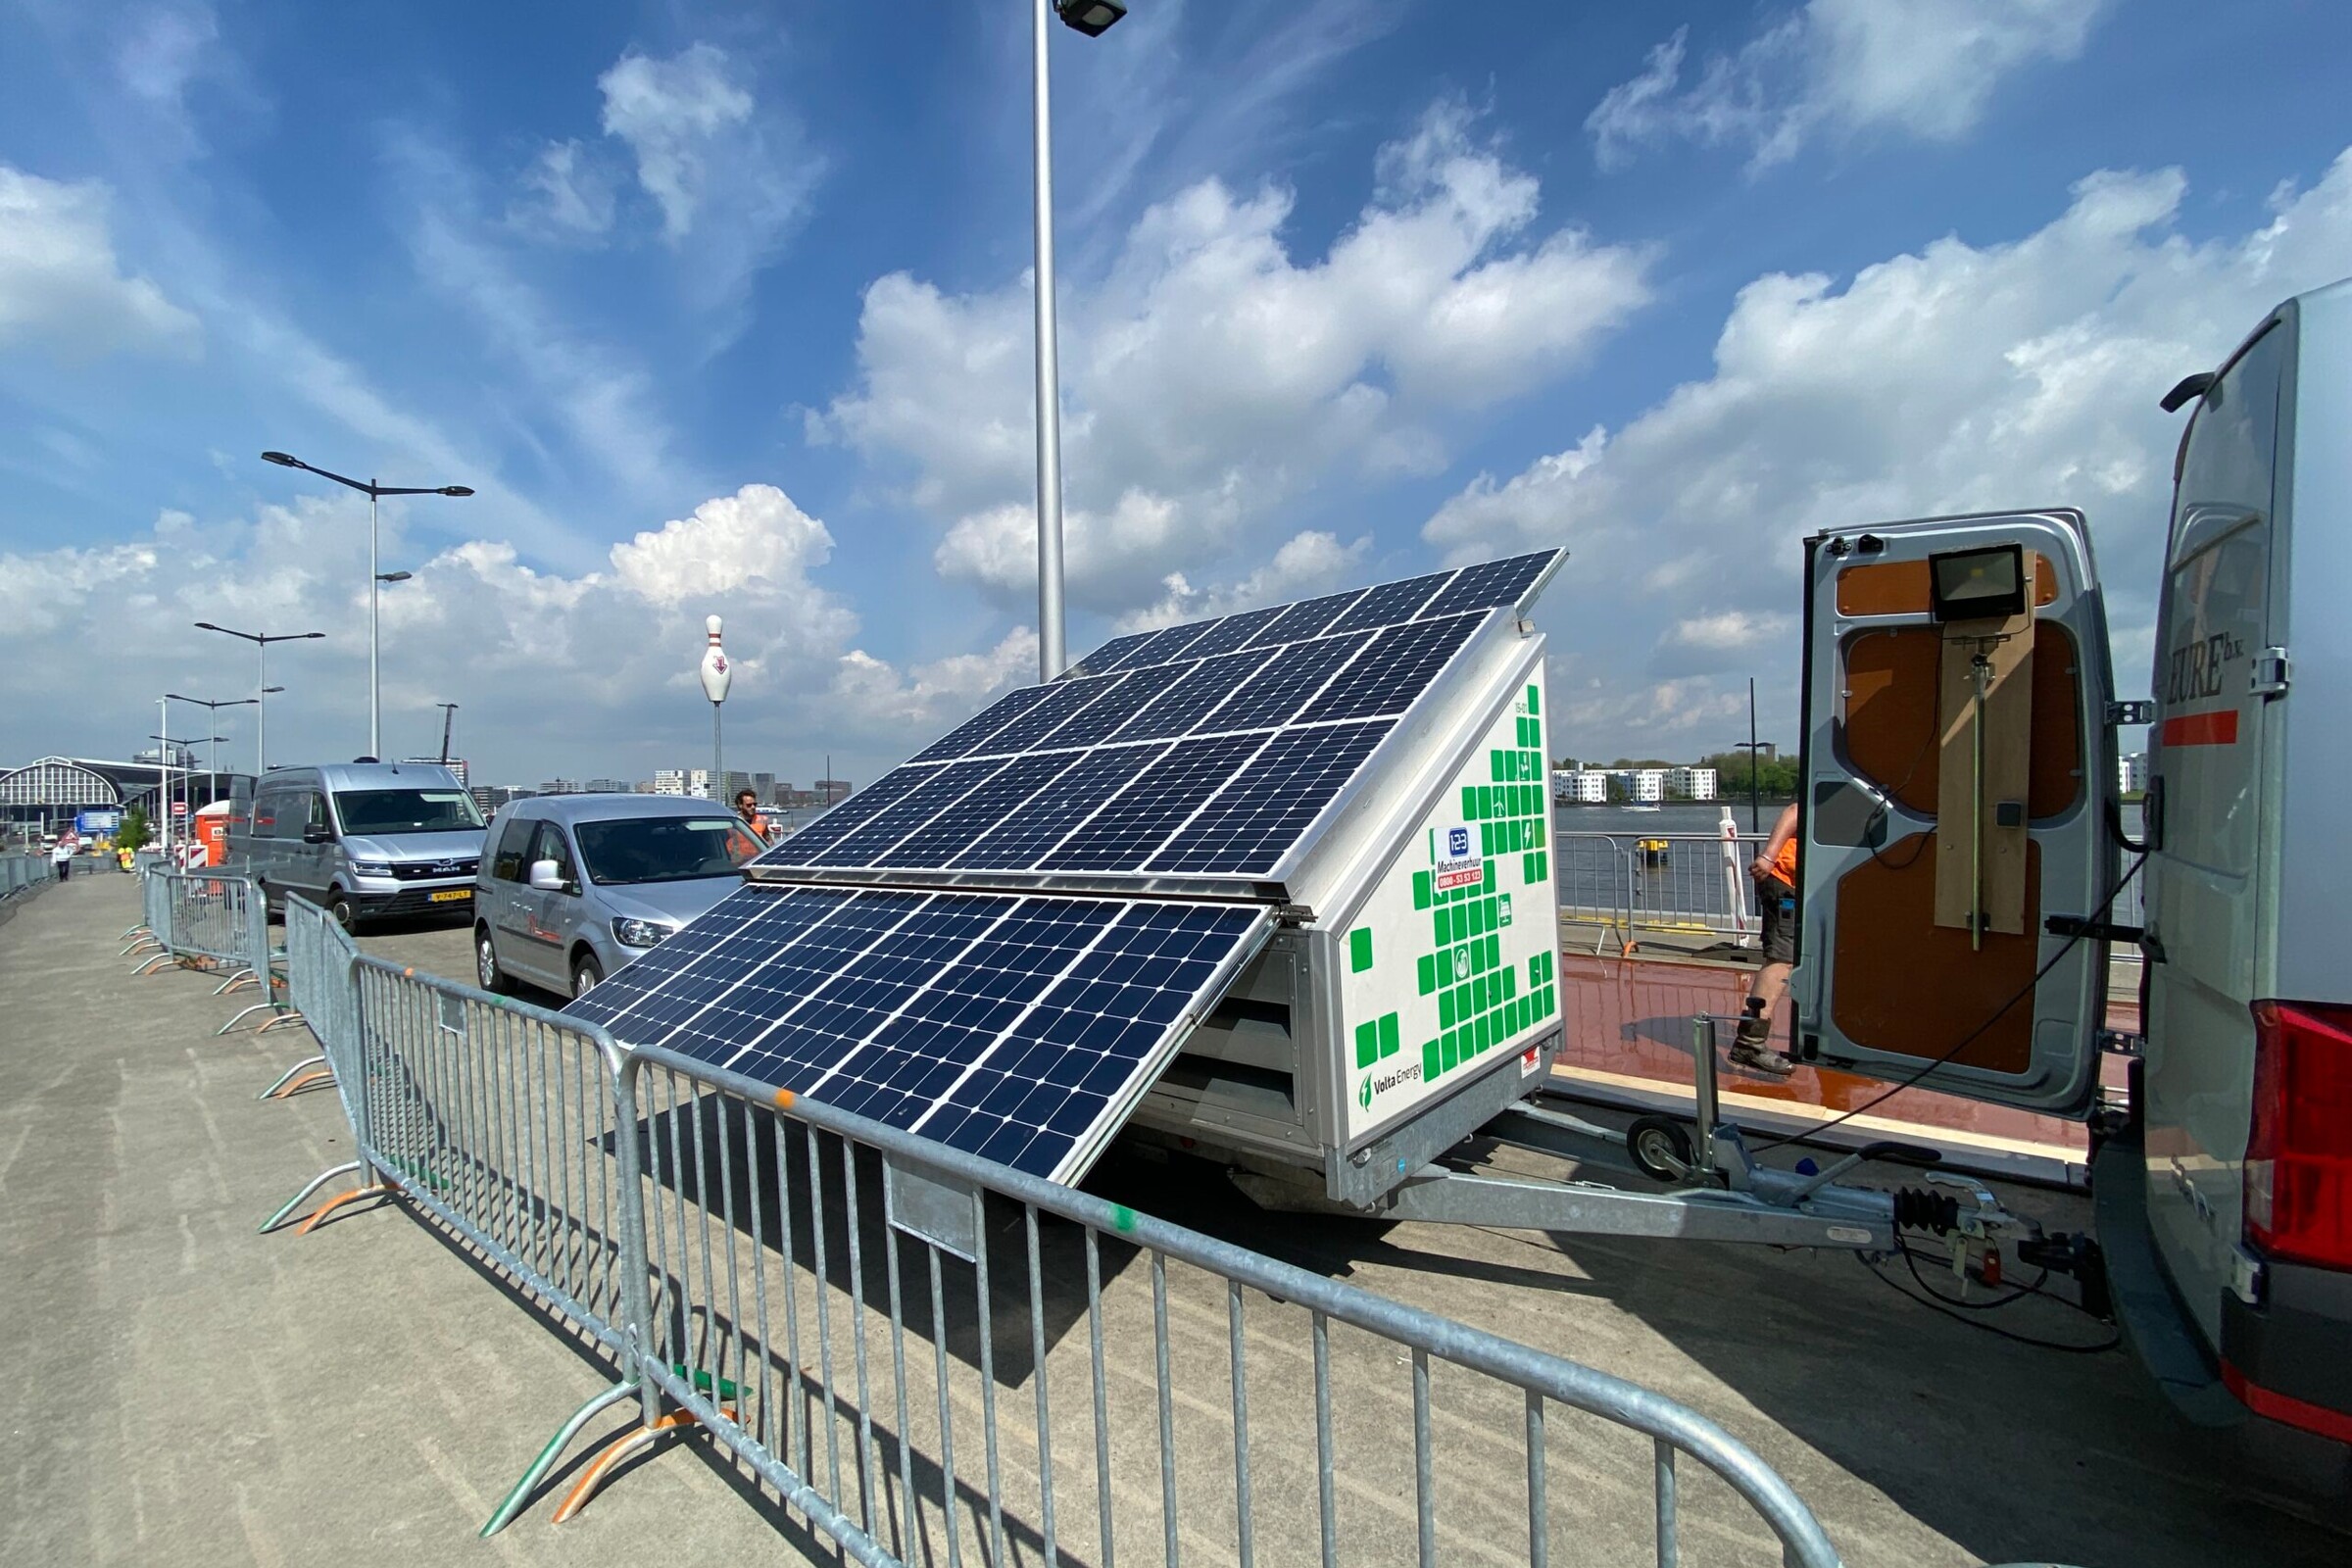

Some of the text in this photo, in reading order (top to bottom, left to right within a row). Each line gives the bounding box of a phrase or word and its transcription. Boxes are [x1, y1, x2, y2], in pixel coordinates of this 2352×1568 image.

[1438, 858, 1481, 872] Machineverhuur
[1375, 1063, 1422, 1095] Volta Energy
